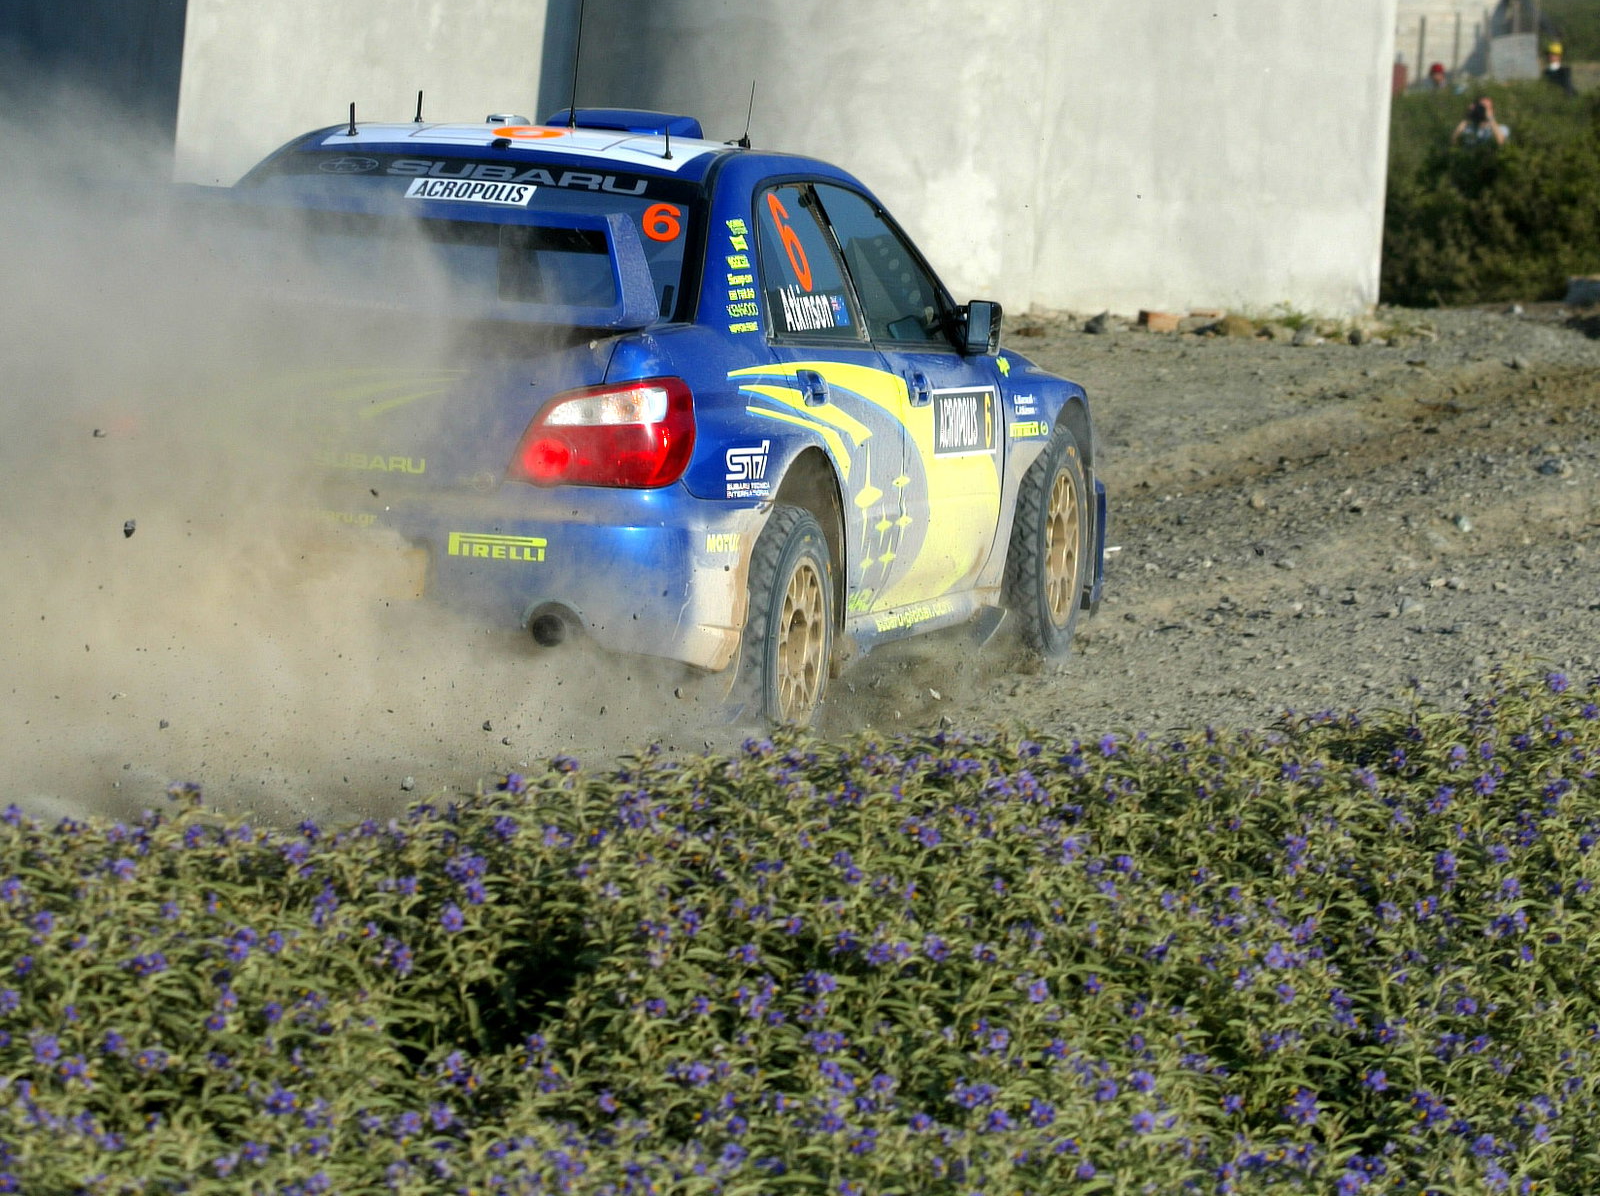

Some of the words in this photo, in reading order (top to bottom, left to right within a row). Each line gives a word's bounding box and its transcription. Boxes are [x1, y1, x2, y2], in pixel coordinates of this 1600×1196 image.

[386, 159, 649, 196] SUBARU
[413, 178, 529, 204] ACROPOLIS
[642, 204, 682, 243] 6
[767, 193, 813, 293] 6
[779, 284, 835, 332] Atkinson
[939, 397, 978, 449] ACROPOLIS
[984, 392, 992, 449] 6
[448, 531, 547, 562] PIRELLI
